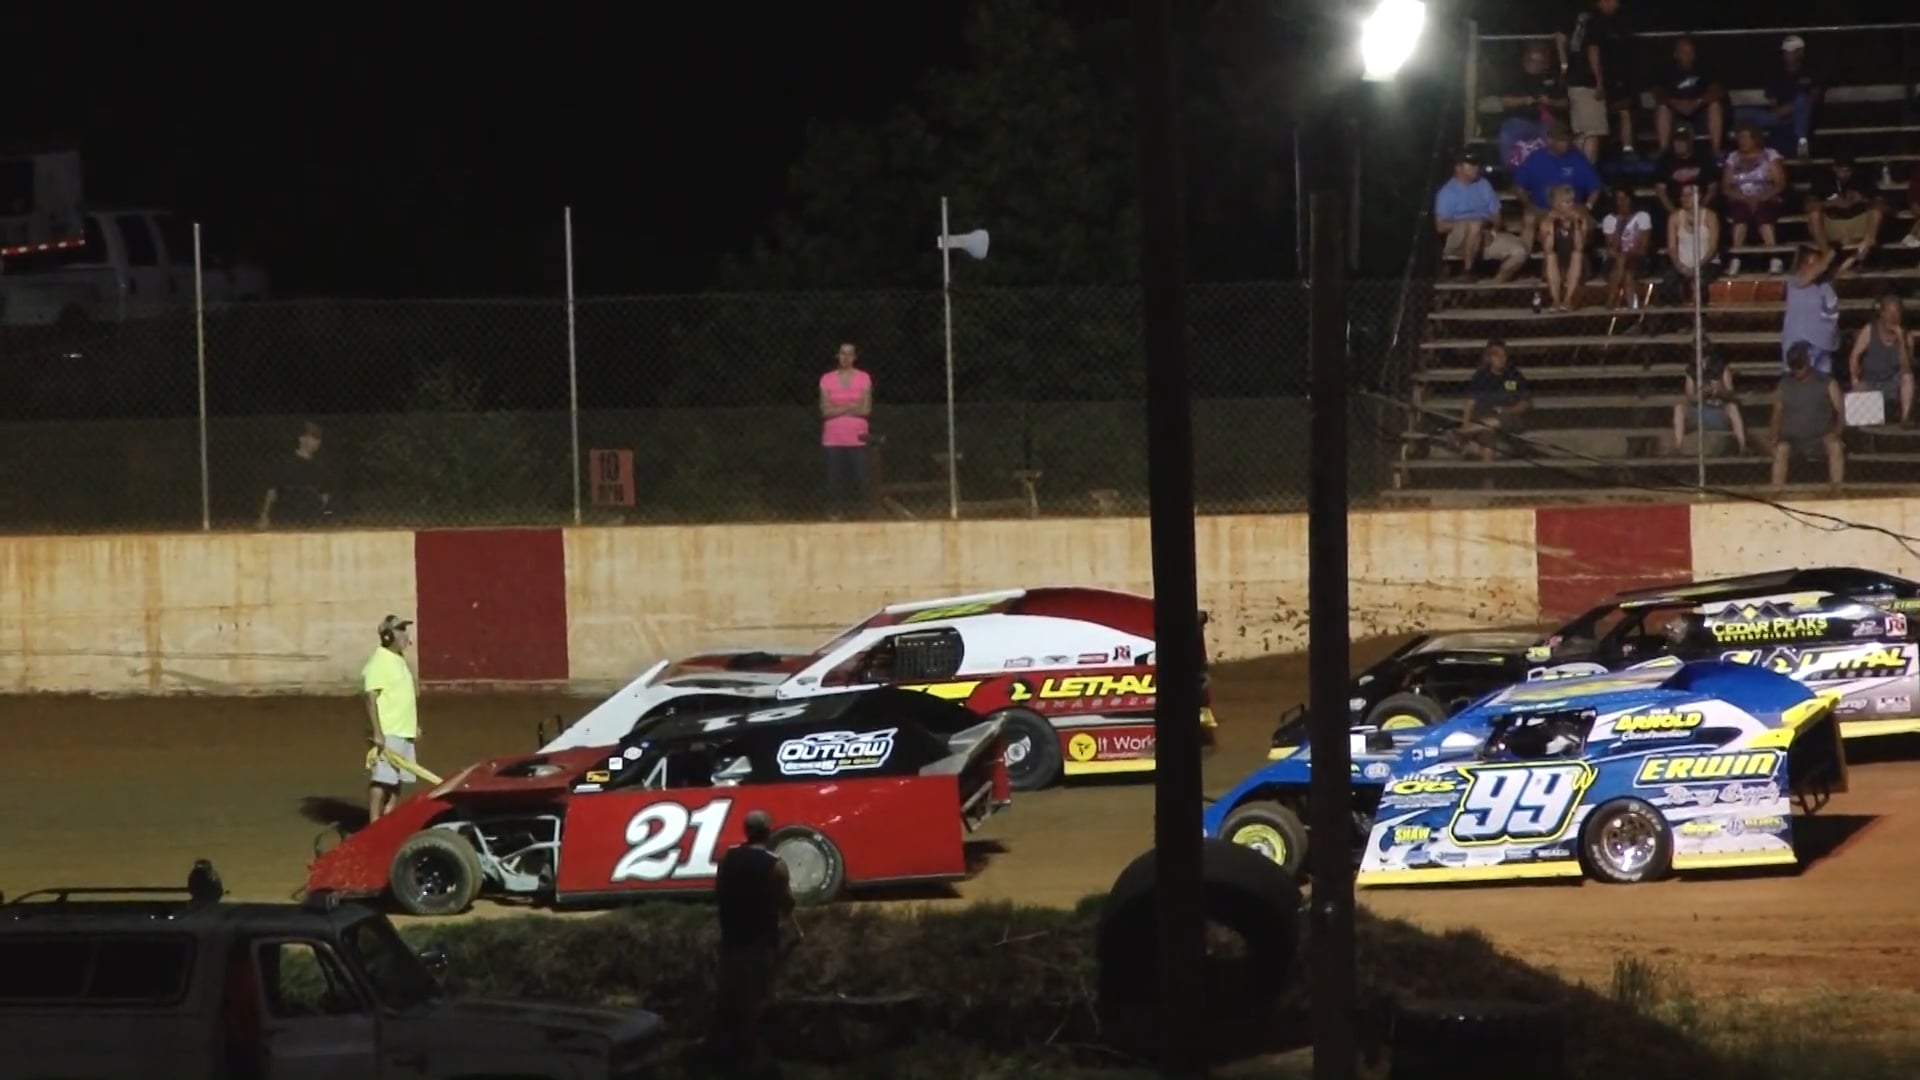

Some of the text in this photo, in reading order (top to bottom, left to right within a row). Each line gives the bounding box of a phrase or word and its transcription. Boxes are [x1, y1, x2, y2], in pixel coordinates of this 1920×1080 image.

[1712, 616, 1828, 637] CEDAR PEAKS
[1040, 675, 1156, 698] LETHAL
[1615, 712, 1702, 730] ARNOLD
[781, 740, 886, 760] OUTLAW
[1640, 753, 1777, 781] ERWIN
[609, 798, 732, 882] 21
[1393, 827, 1430, 842] SHAW
